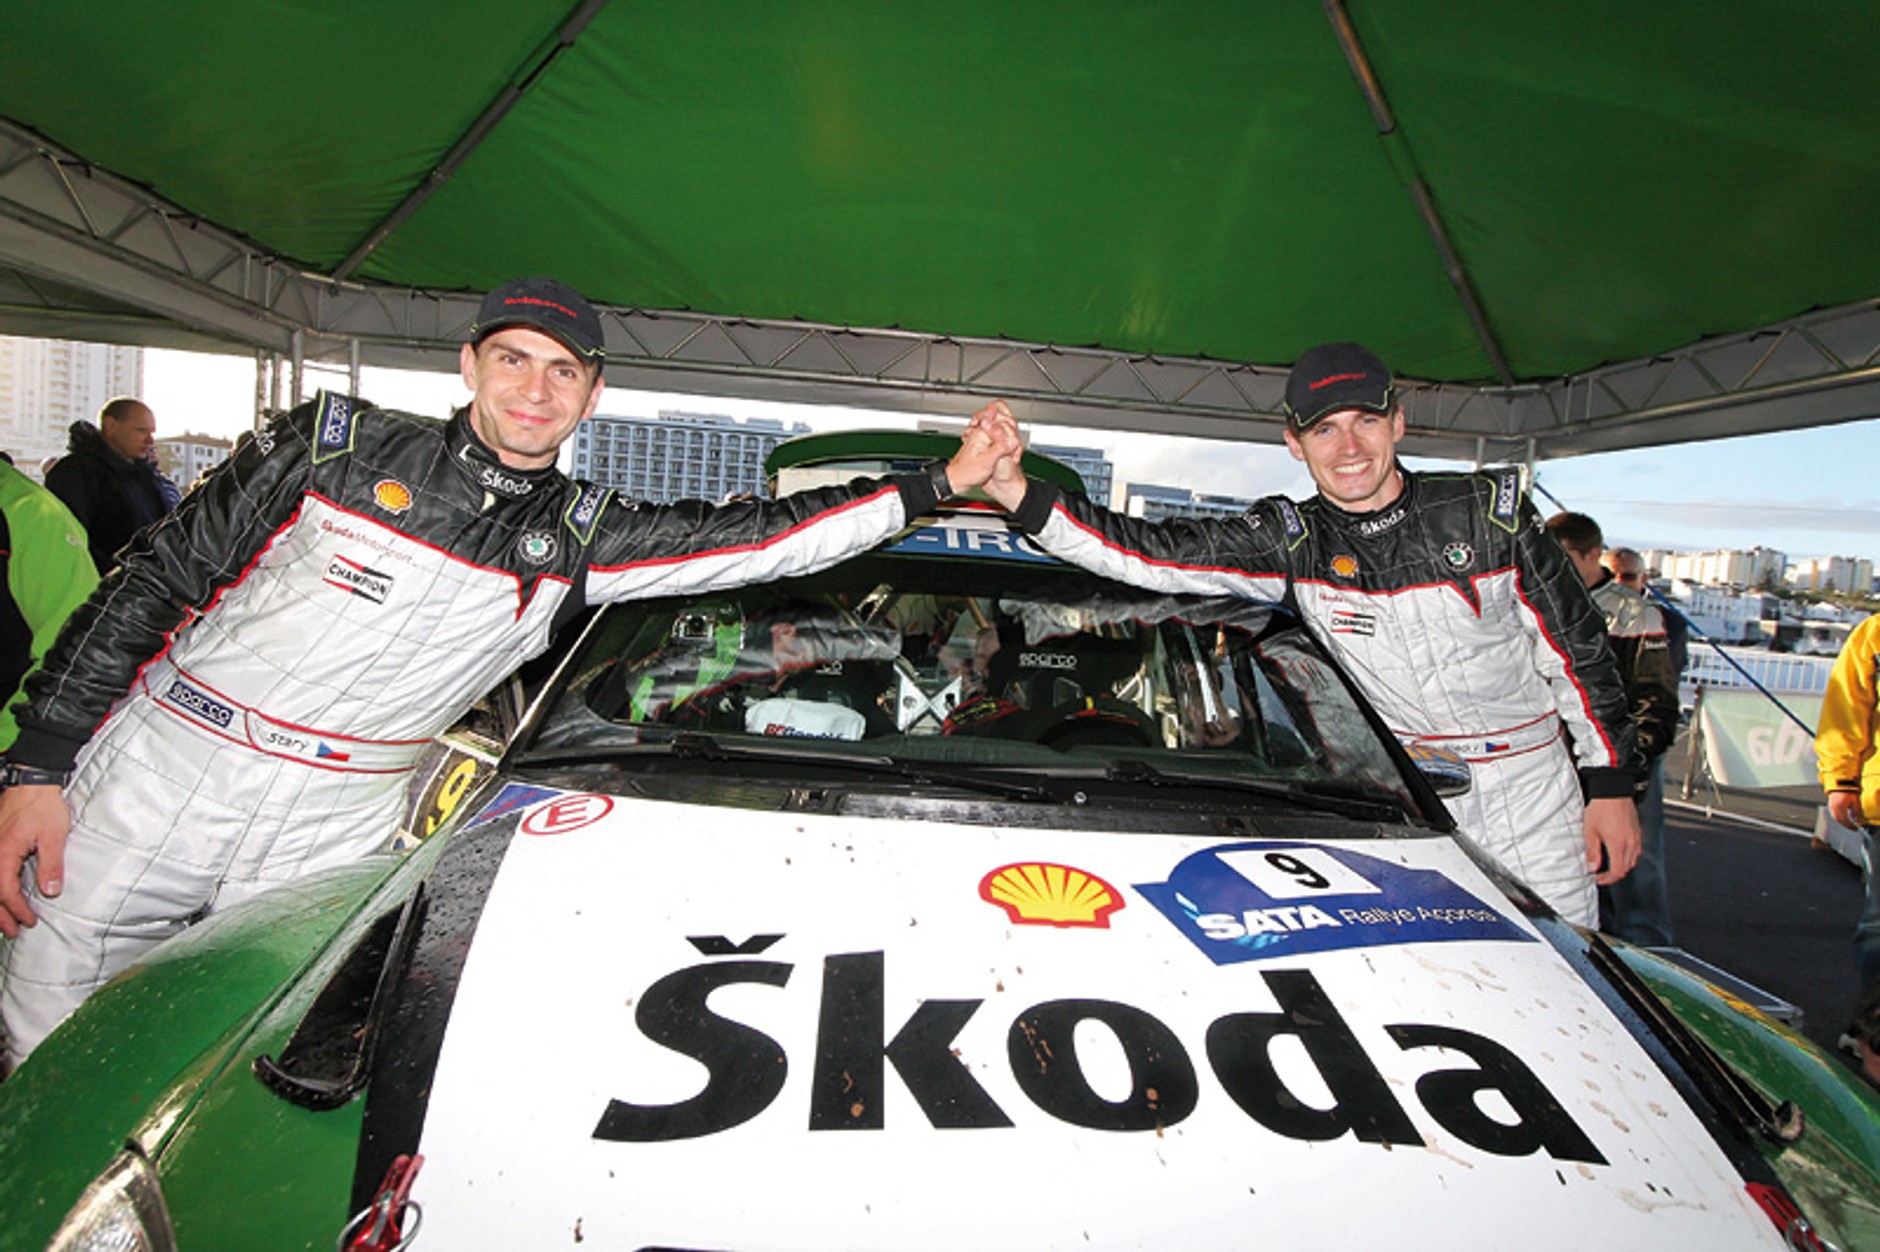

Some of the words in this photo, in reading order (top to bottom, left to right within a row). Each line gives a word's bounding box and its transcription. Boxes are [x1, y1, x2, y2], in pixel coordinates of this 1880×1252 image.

[328, 563, 388, 595] CHAMPION
[1264, 852, 1331, 890] 9
[1196, 904, 1343, 941] SATA
[1338, 908, 1416, 926] Rallye
[591, 933, 1611, 1167] Škoda
